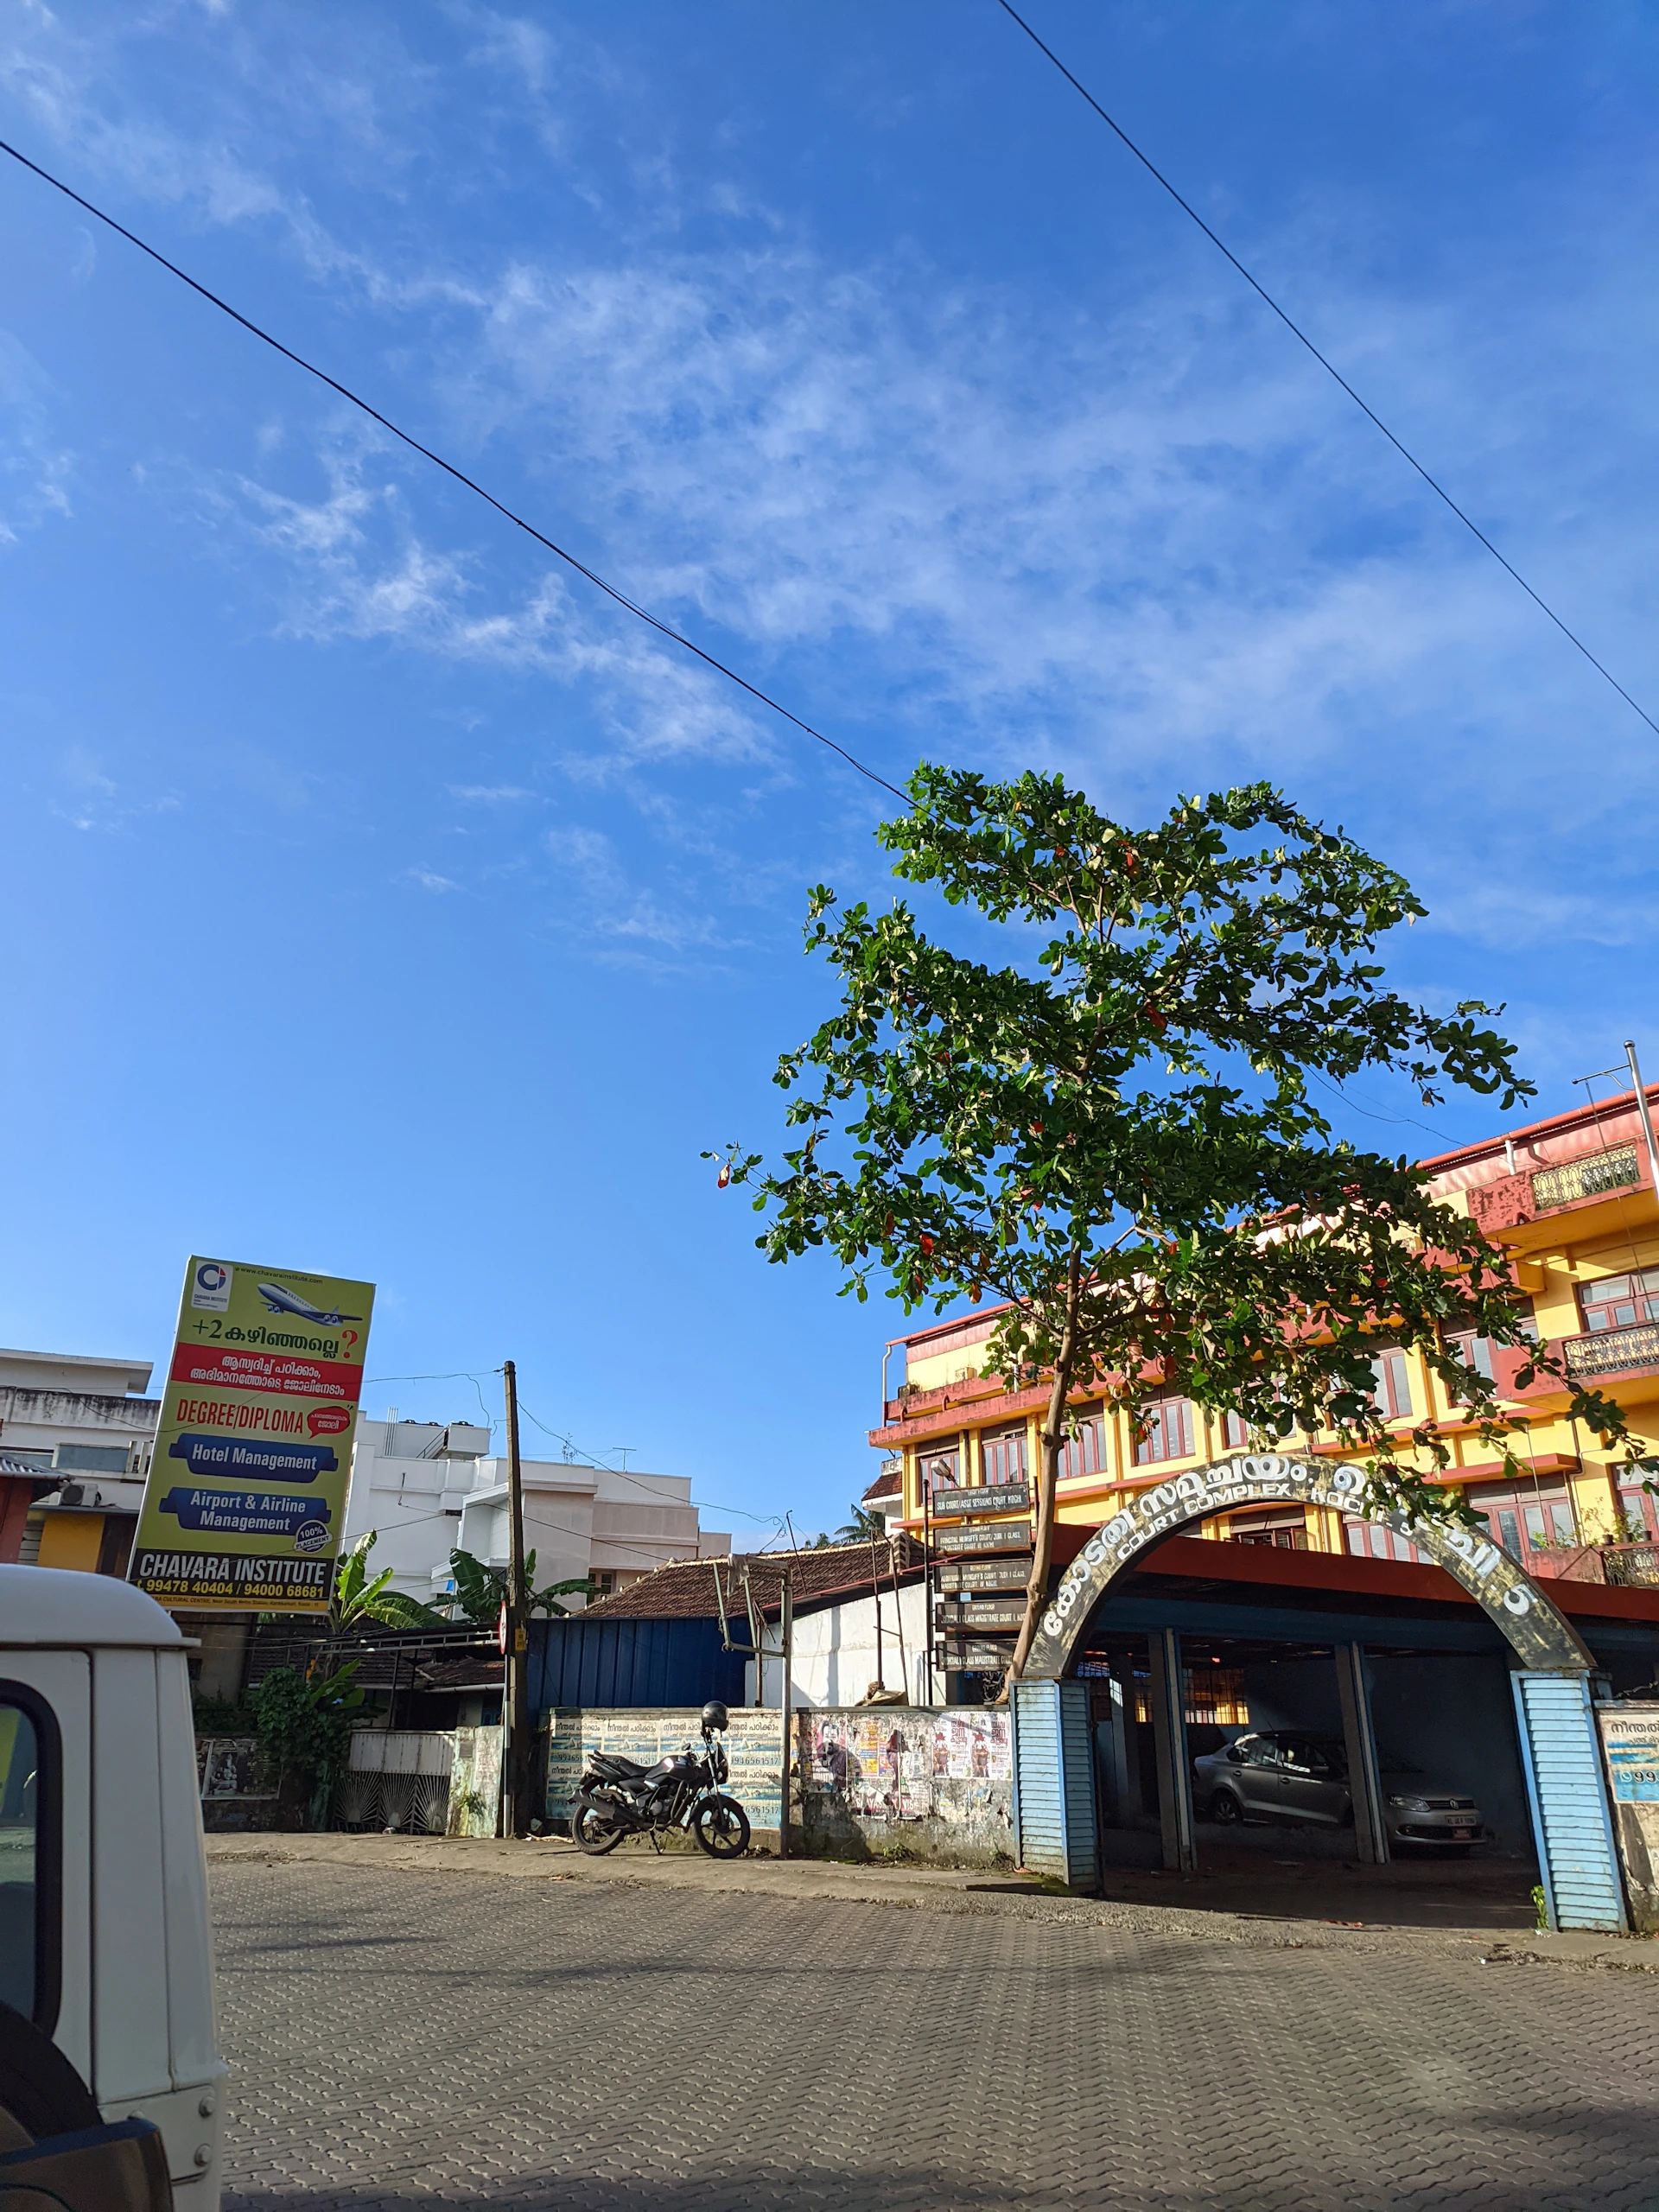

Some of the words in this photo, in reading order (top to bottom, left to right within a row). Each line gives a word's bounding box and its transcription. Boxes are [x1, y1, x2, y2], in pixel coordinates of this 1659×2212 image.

[240, 1267, 323, 1284] www.chavarainstitute.com
[176, 1398, 303, 1433] DEGREE/DIPLOMA
[192, 1443, 229, 1462] Hotel
[232, 1446, 317, 1471] Management
[190, 1491, 241, 1510] Airport
[245, 1495, 256, 1510] &
[260, 1496, 306, 1513] Airline
[937, 1501, 945, 1510] SUB
[972, 1497, 992, 1507] SESSIONS
[200, 1510, 290, 1531] Management
[1116, 1510, 1179, 1560] COURT
[1184, 1483, 1293, 1515] COMPLEX
[300, 1526, 323, 1539] 100%
[296, 1535, 330, 1550] PLACEMENT
[139, 1553, 230, 1580] CHAVARA
[234, 1558, 327, 1585] INSTITUTE
[146, 1579, 188, 1593] 99478
[191, 1580, 233, 1595] 40404
[244, 1584, 283, 1597] 94000
[286, 1585, 324, 1599] 68681
[975, 1613, 999, 1623] MAGISTRATE
[975, 1656, 1001, 1665] MAGISTRATE
[745, 1805, 779, 1815] 6561517
